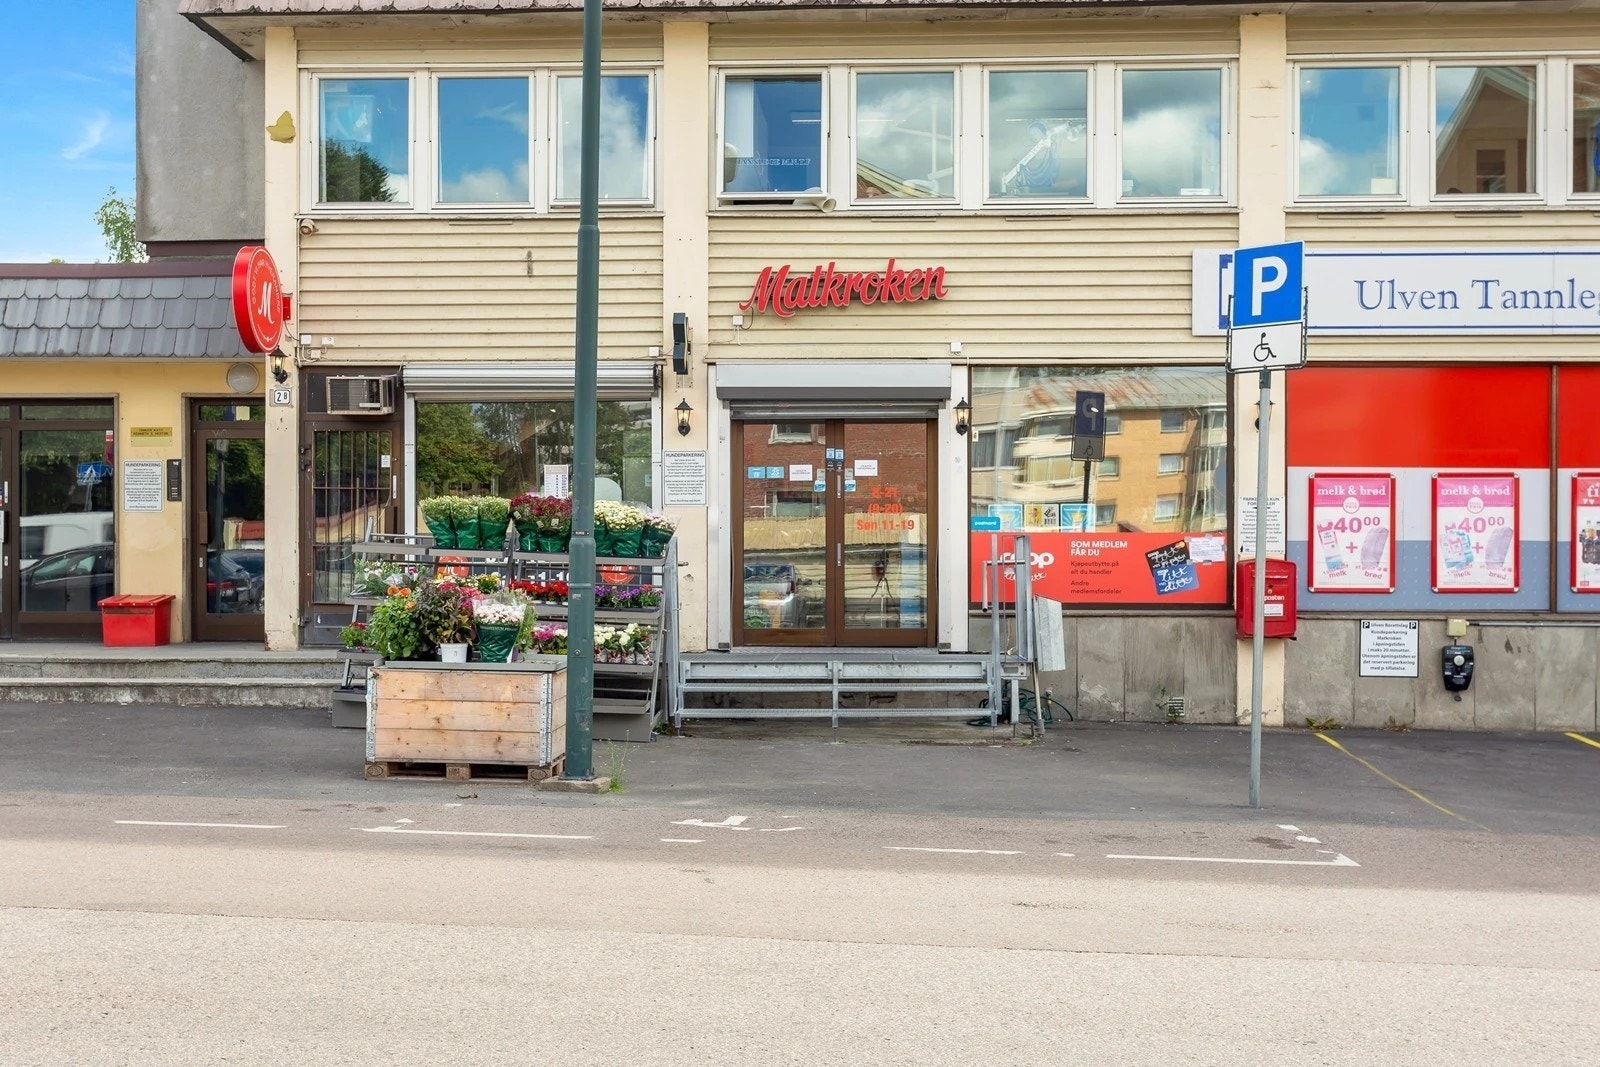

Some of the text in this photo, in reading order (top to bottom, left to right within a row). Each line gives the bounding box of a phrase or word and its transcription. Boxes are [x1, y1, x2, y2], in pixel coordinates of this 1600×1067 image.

[739, 257, 949, 318] Matkroken
[1251, 255, 1288, 317] P
[1353, 277, 1600, 317] Ulven Tannle
[1317, 485, 1386, 496] melk & brød
[1441, 485, 1511, 496] melk & brød
[857, 519, 915, 531] Søn 11-19
[1070, 540, 1128, 548] SOM MEDLEM
[1070, 547, 1086, 556] FÅR
[1328, 570, 1347, 579] melk
[1364, 570, 1383, 580] brød
